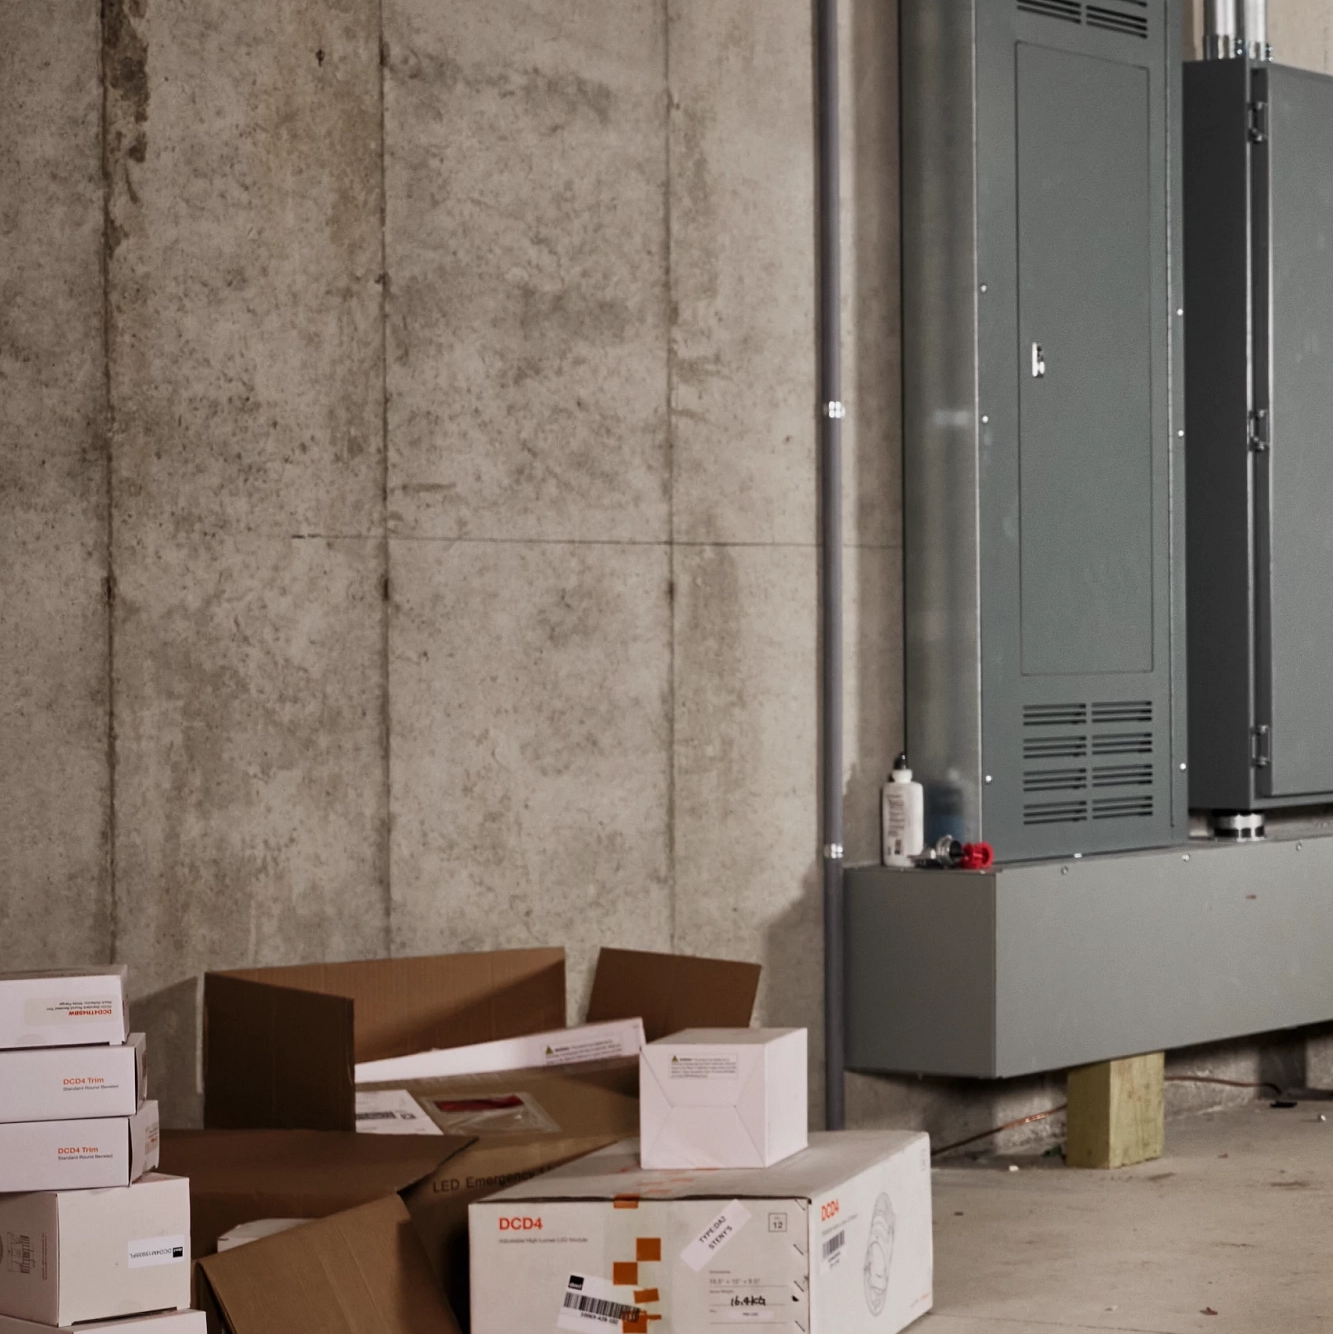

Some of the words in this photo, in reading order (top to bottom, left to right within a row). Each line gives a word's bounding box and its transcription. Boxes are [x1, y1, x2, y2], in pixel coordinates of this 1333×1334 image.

[63, 1077, 85, 1085] DCD4
[432, 1178, 460, 1193] LED
[821, 1199, 839, 1222] DCD4
[499, 1217, 543, 1230] DCD4
[773, 1221, 783, 1229] 12
